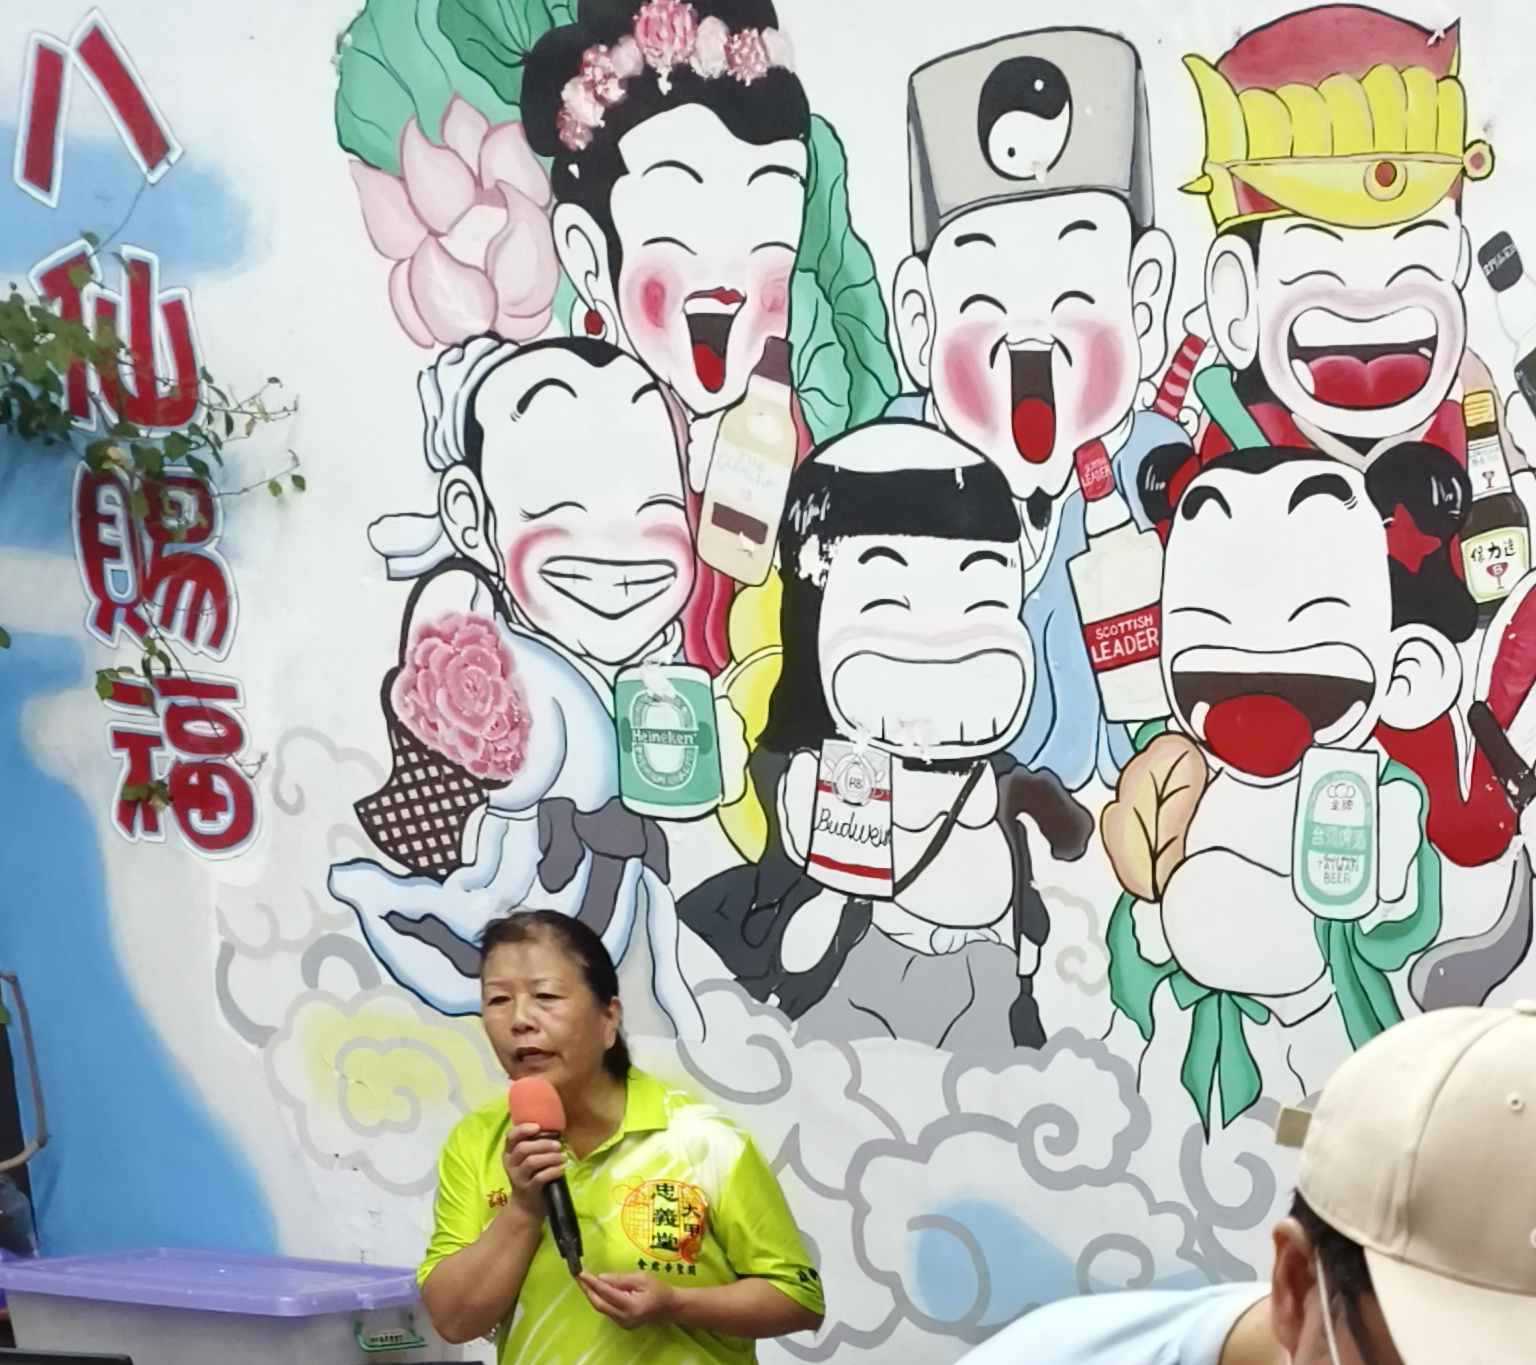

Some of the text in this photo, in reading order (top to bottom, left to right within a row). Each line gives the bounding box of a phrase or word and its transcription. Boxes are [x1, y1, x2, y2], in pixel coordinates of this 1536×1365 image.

[14, 8, 260, 860] 八仙賜福
[1095, 614, 1153, 640] SCOTTISH
[1090, 627, 1159, 663] LEADER
[631, 728, 695, 745] Heineken
[1317, 860, 1359, 873] TAIWAN
[1323, 872, 1351, 885] BEER
